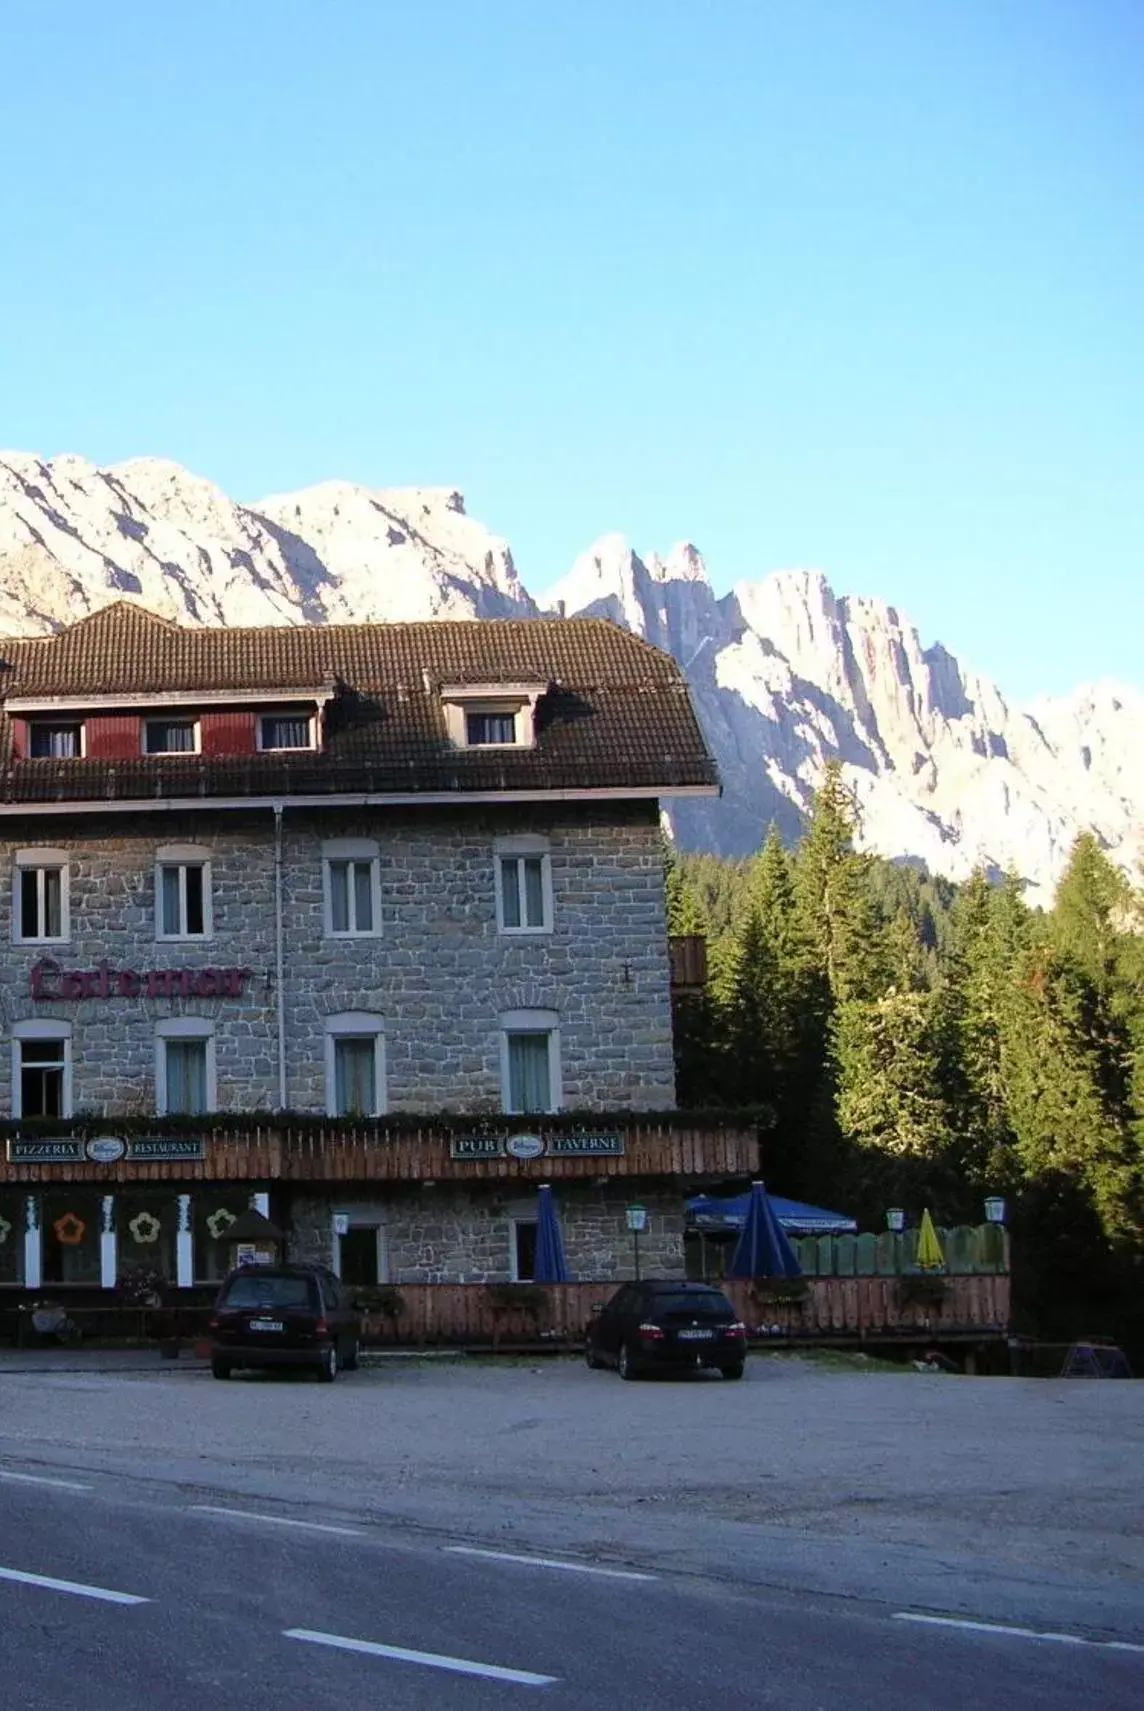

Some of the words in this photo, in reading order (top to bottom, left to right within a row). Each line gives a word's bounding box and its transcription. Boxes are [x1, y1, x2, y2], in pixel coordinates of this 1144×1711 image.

[15, 1143, 75, 1155] PIZZERIA
[134, 1142, 198, 1154] RESTAURANT
[458, 1139, 495, 1153] PUB
[554, 1136, 618, 1150] TAVERNE
